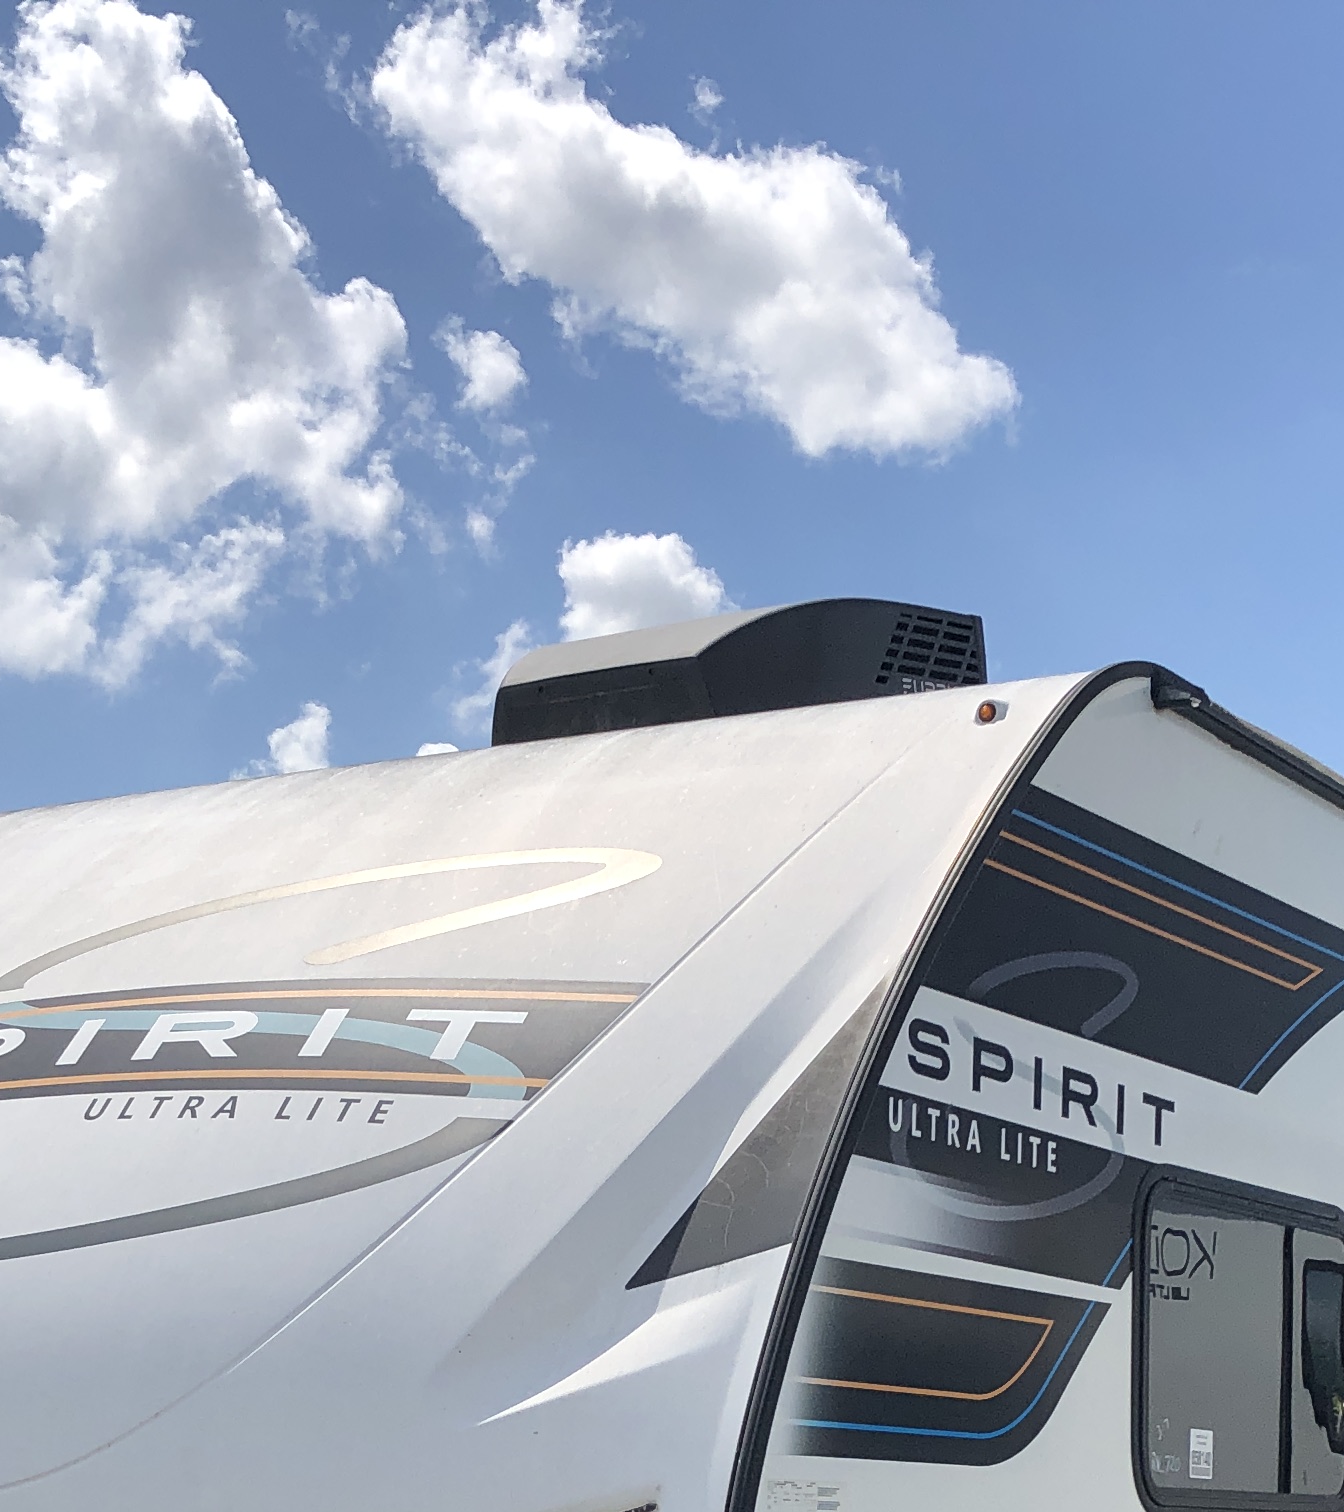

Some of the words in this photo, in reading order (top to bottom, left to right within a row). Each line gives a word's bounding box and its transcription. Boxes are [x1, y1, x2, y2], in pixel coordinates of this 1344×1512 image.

[83, 1095, 237, 1121] ULTRA
[274, 1097, 395, 1125] LITE
[906, 1017, 1176, 1147] SPIRIT
[887, 1096, 982, 1154] ULTRA
[999, 1127, 1058, 1173] LITE
